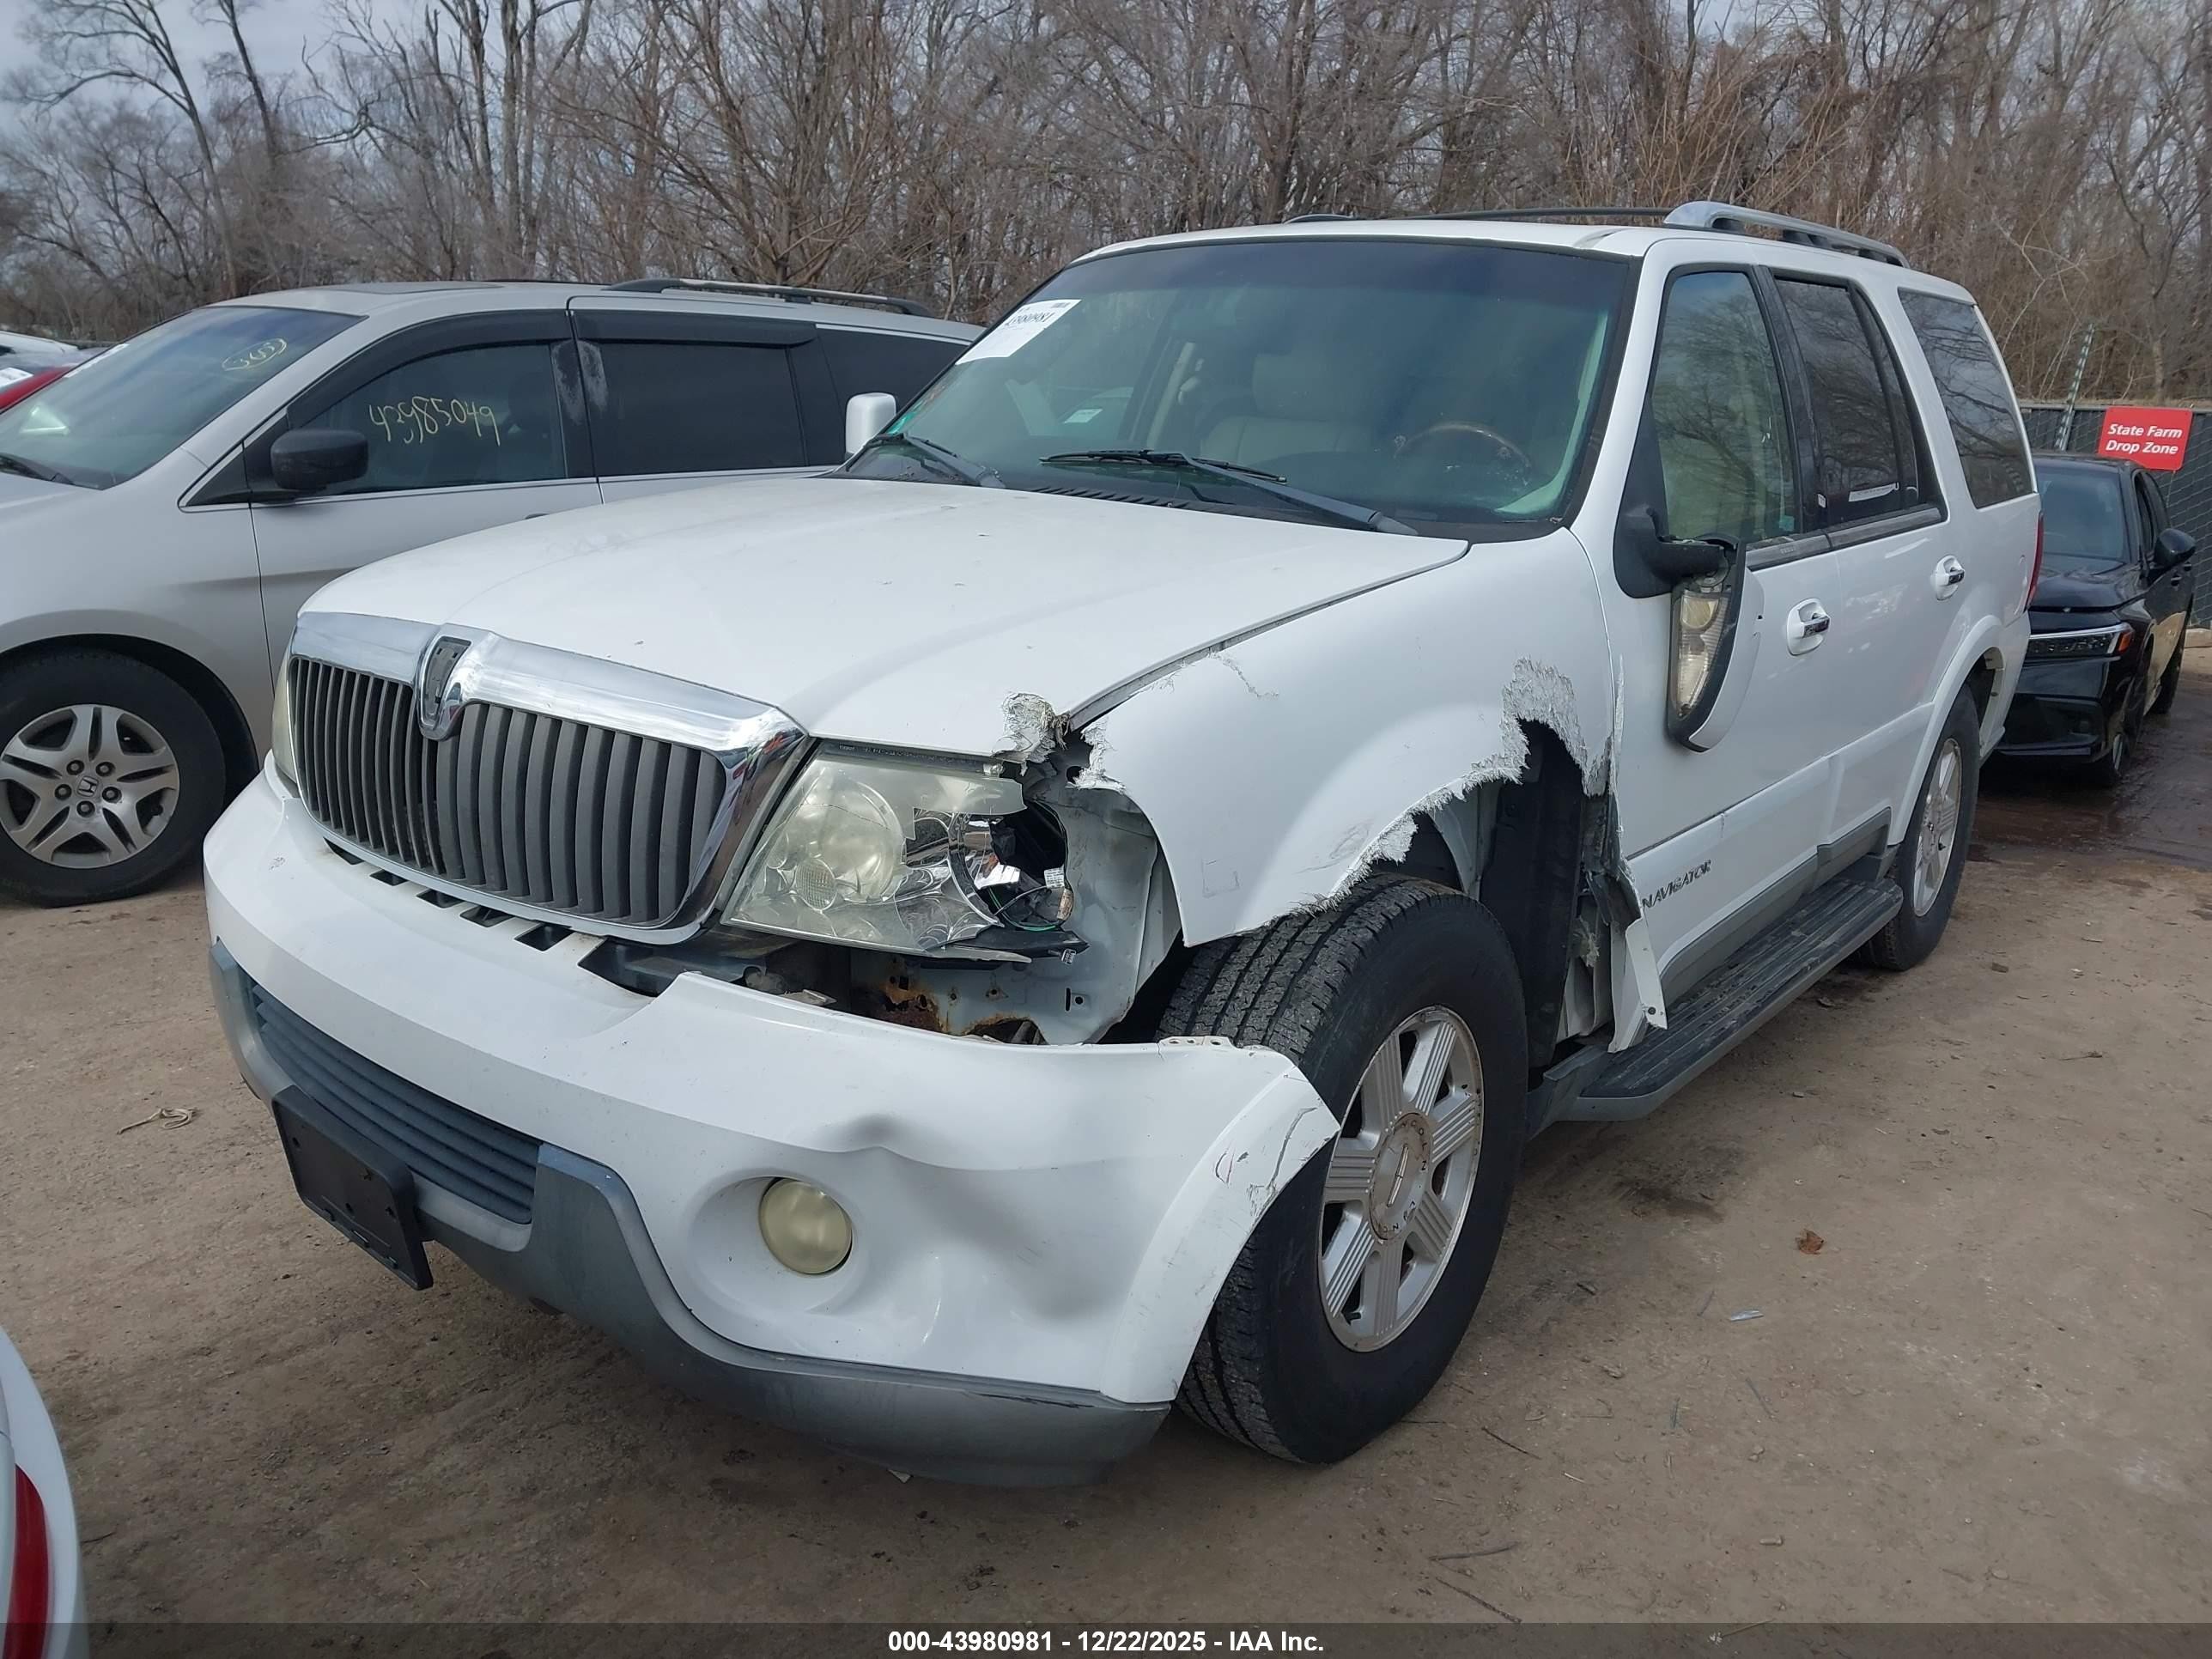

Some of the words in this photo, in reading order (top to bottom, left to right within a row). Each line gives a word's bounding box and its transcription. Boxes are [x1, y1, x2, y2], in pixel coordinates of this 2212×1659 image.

[2107, 423, 2144, 435] State
[2147, 426, 2183, 438] Farm
[2106, 440, 2140, 453] Drop
[2142, 442, 2179, 454] Zone
[1642, 859, 1712, 908] NAVIGATOR
